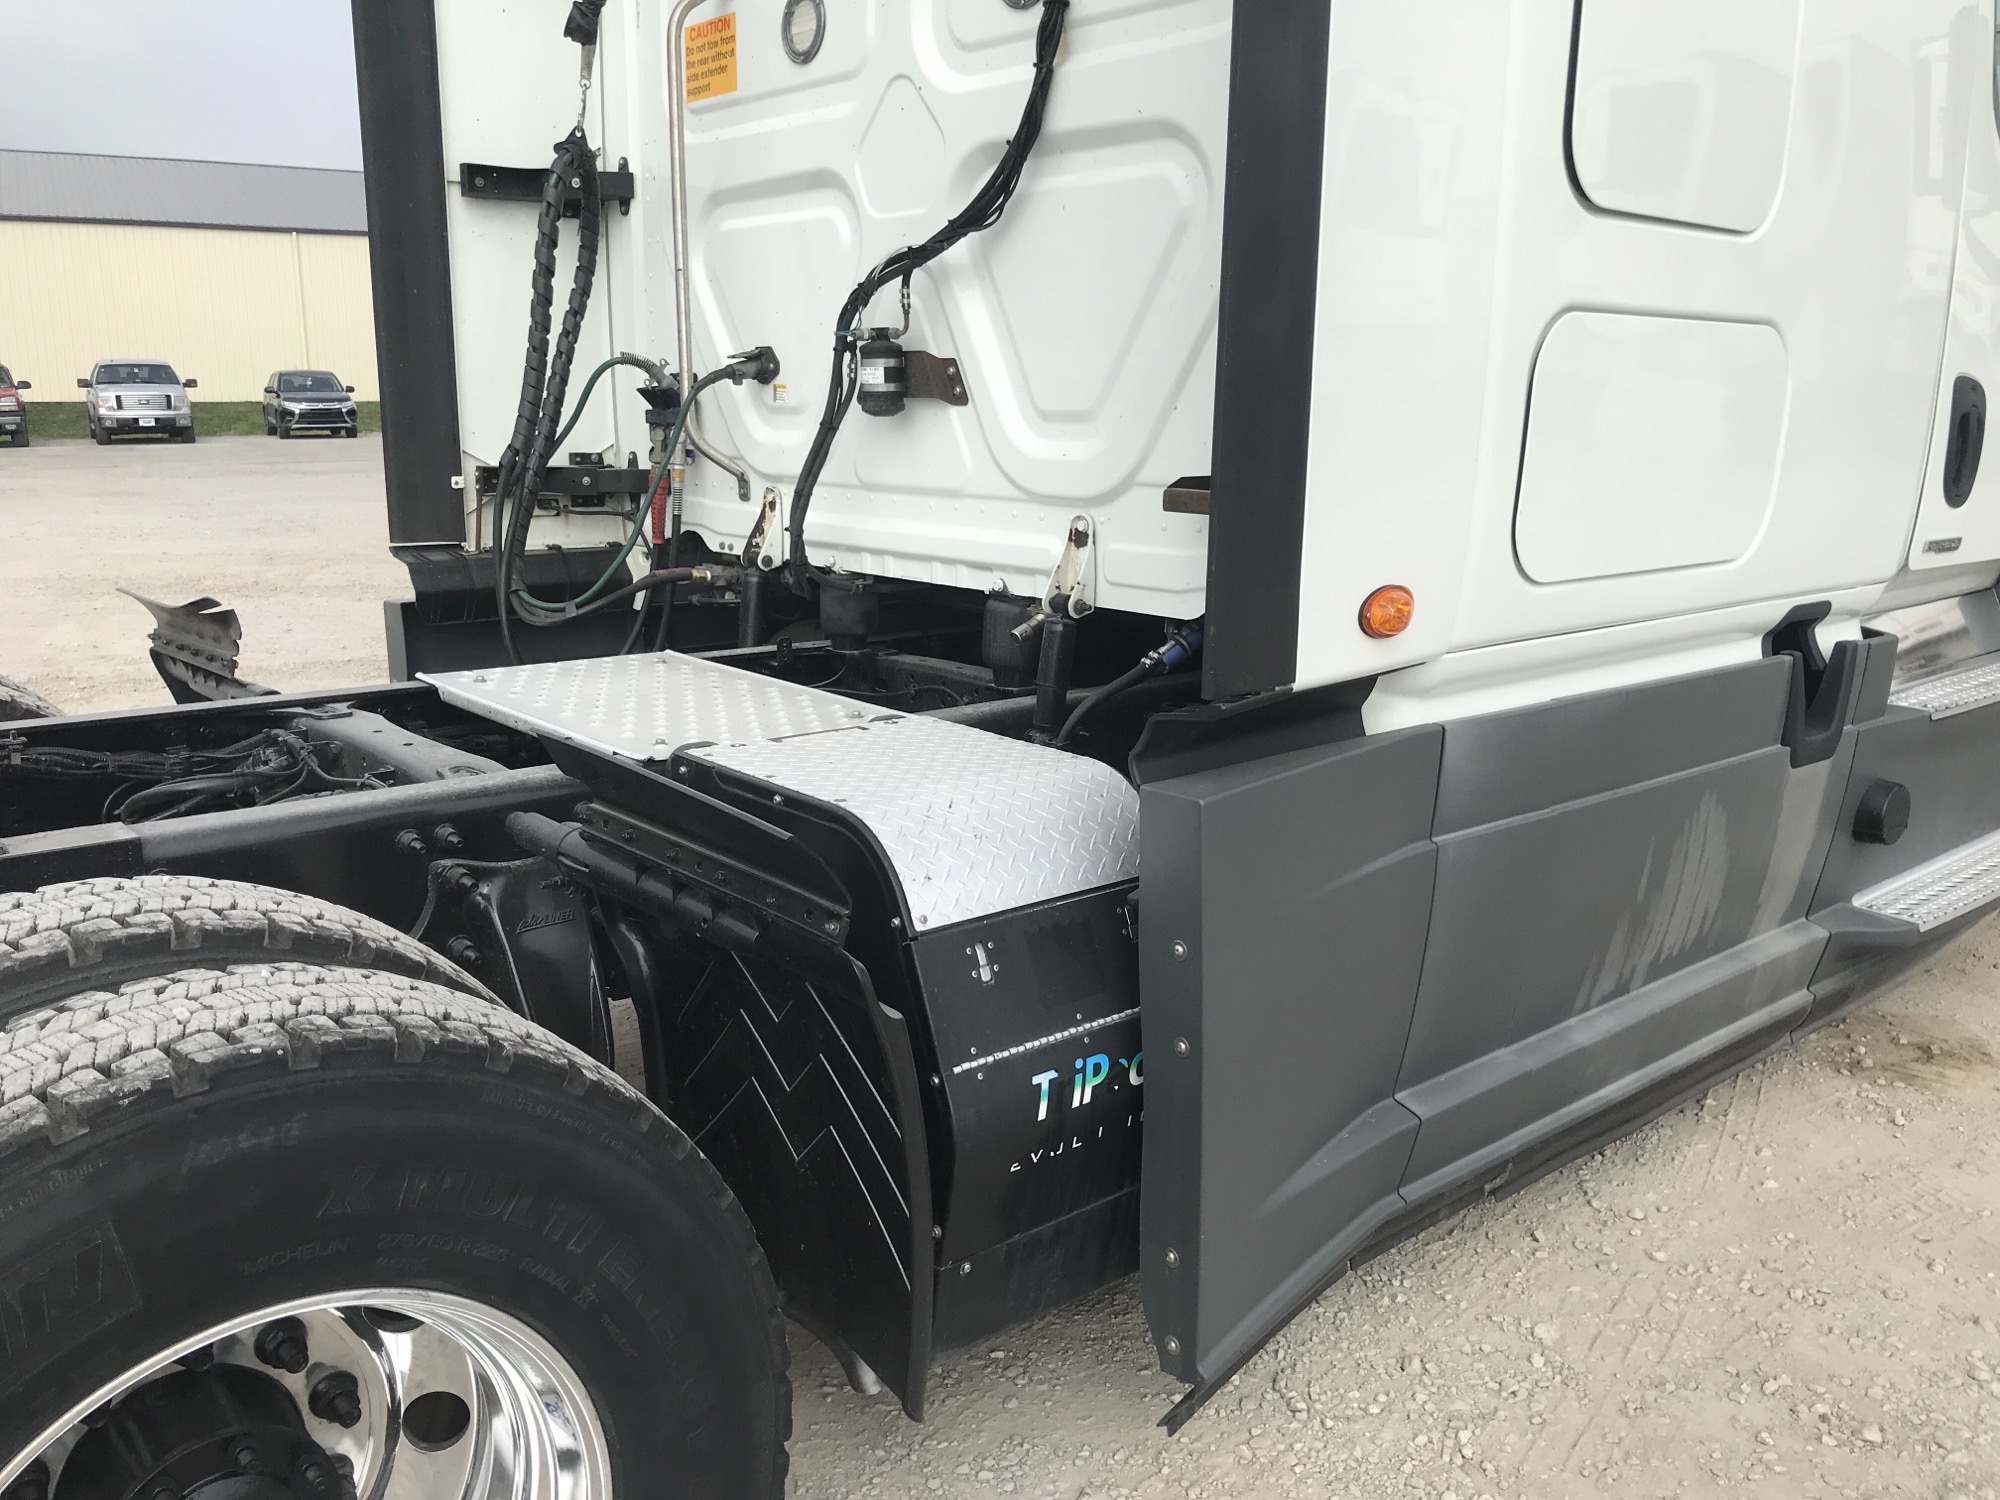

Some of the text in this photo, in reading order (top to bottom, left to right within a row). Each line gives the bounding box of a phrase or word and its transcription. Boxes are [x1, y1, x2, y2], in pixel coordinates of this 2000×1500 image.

[690, 17, 731, 41] CAUTION
[686, 34, 735, 57] Do not tow from
[686, 47, 734, 70] the rear without
[687, 64, 728, 83] side extender
[687, 82, 711, 97] support
[397, 1166, 605, 1254] MULTI
[241, 1237, 352, 1277] MICHELIN
